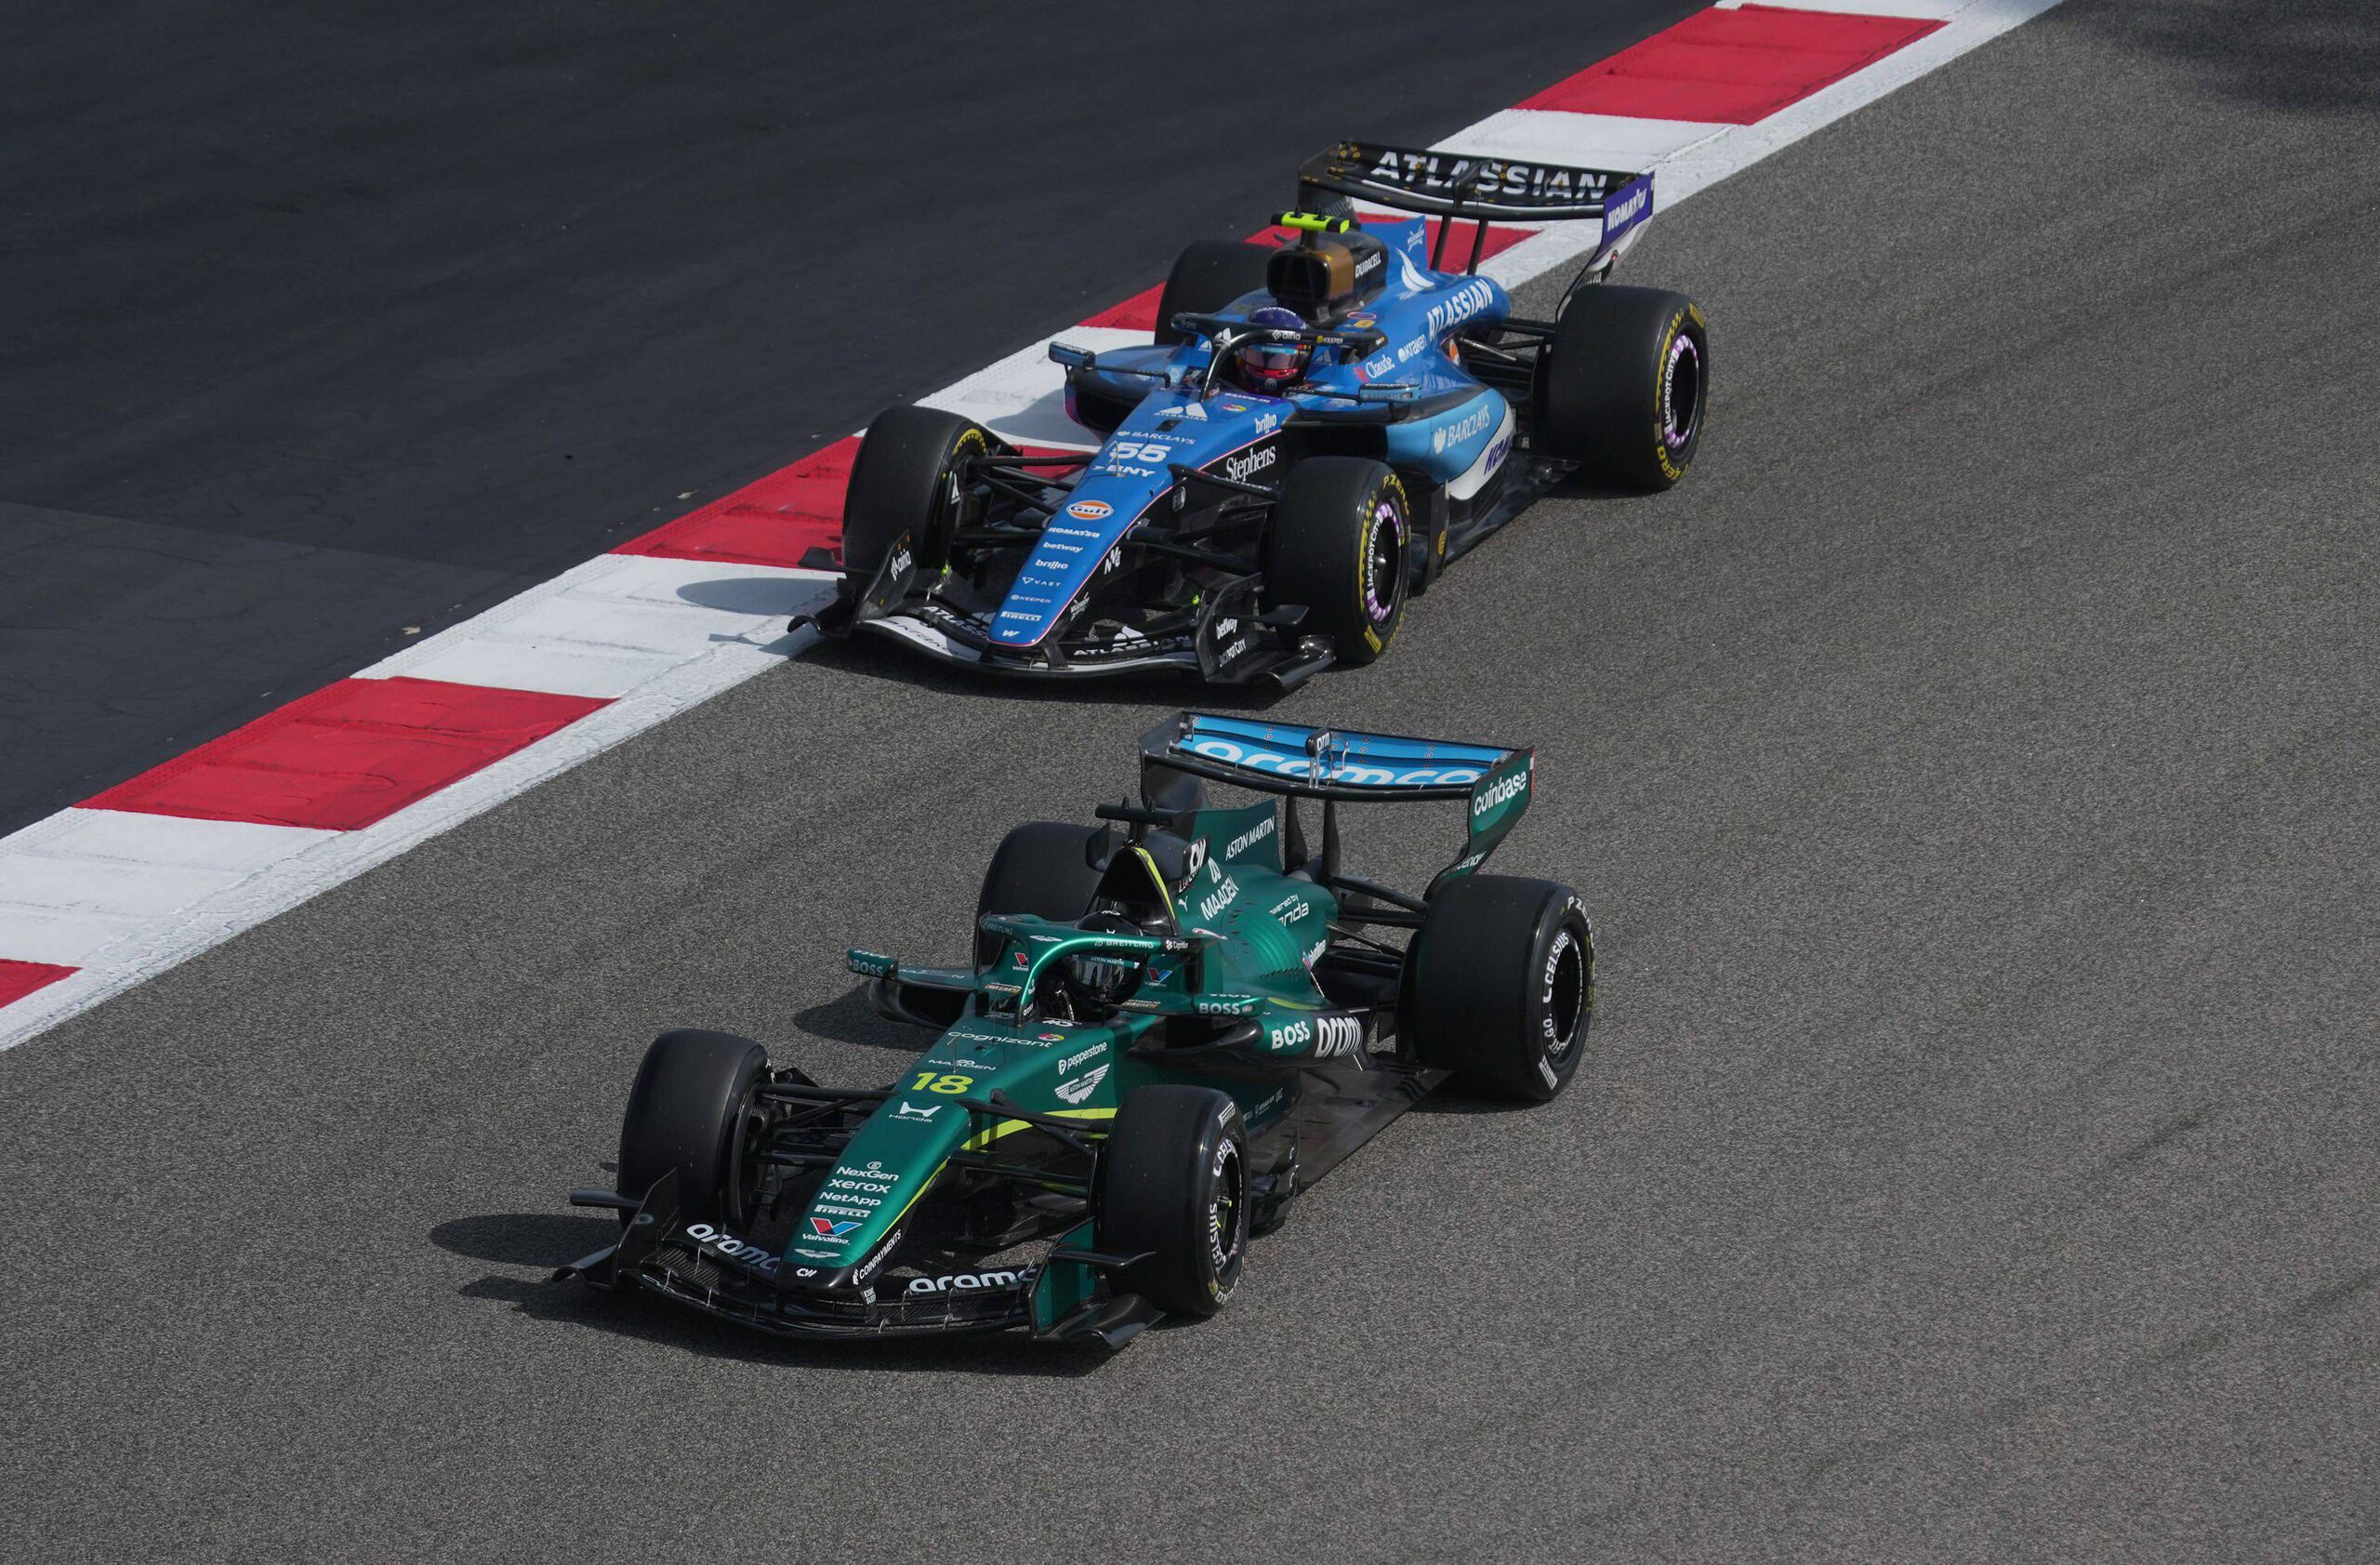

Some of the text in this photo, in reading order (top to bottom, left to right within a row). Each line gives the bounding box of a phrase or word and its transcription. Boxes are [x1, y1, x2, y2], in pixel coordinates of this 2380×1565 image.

[1370, 151, 1607, 200] ATLASSIAN
[1427, 278, 1493, 342] ATLASSIAN
[1366, 353, 1395, 378] Claude
[1448, 405, 1490, 447] BARCLAYS
[1130, 431, 1197, 445] BARCLAYS
[1110, 442, 1173, 463] 55
[1226, 445, 1276, 483] Stephens
[1106, 465, 1156, 478] BNY
[1070, 505, 1112, 516] Gulf
[1048, 526, 1101, 538] KOMATSU
[1042, 542, 1083, 553] betway
[1367, 519, 1381, 588] JACKPOT CITY
[1035, 559, 1068, 570] brillio
[1195, 741, 1482, 785] aramco
[1474, 770, 1527, 816] coinbase
[1225, 832, 1249, 861] ASTON
[1249, 816, 1276, 846] MARTIN
[1200, 874, 1240, 922] MAADEN
[853, 959, 884, 977] BOSS
[1543, 932, 1569, 985] CELSIUS
[1198, 1002, 1240, 1015] BOSS
[947, 1031, 1053, 1049] cognizant
[1271, 1021, 1311, 1050] BOSS
[1067, 1041, 1107, 1070] pepperstone
[911, 1072, 974, 1094] 18
[836, 1166, 899, 1182] NexGen
[827, 1179, 892, 1194] xerox
[819, 1191, 882, 1207] NetApp
[813, 1204, 871, 1218] PIRELLI
[686, 1224, 781, 1271] aramc
[802, 1233, 850, 1245] Valvoline
[859, 1228, 902, 1280] COINPAYMENTS
[908, 1267, 1038, 1293] aramc
